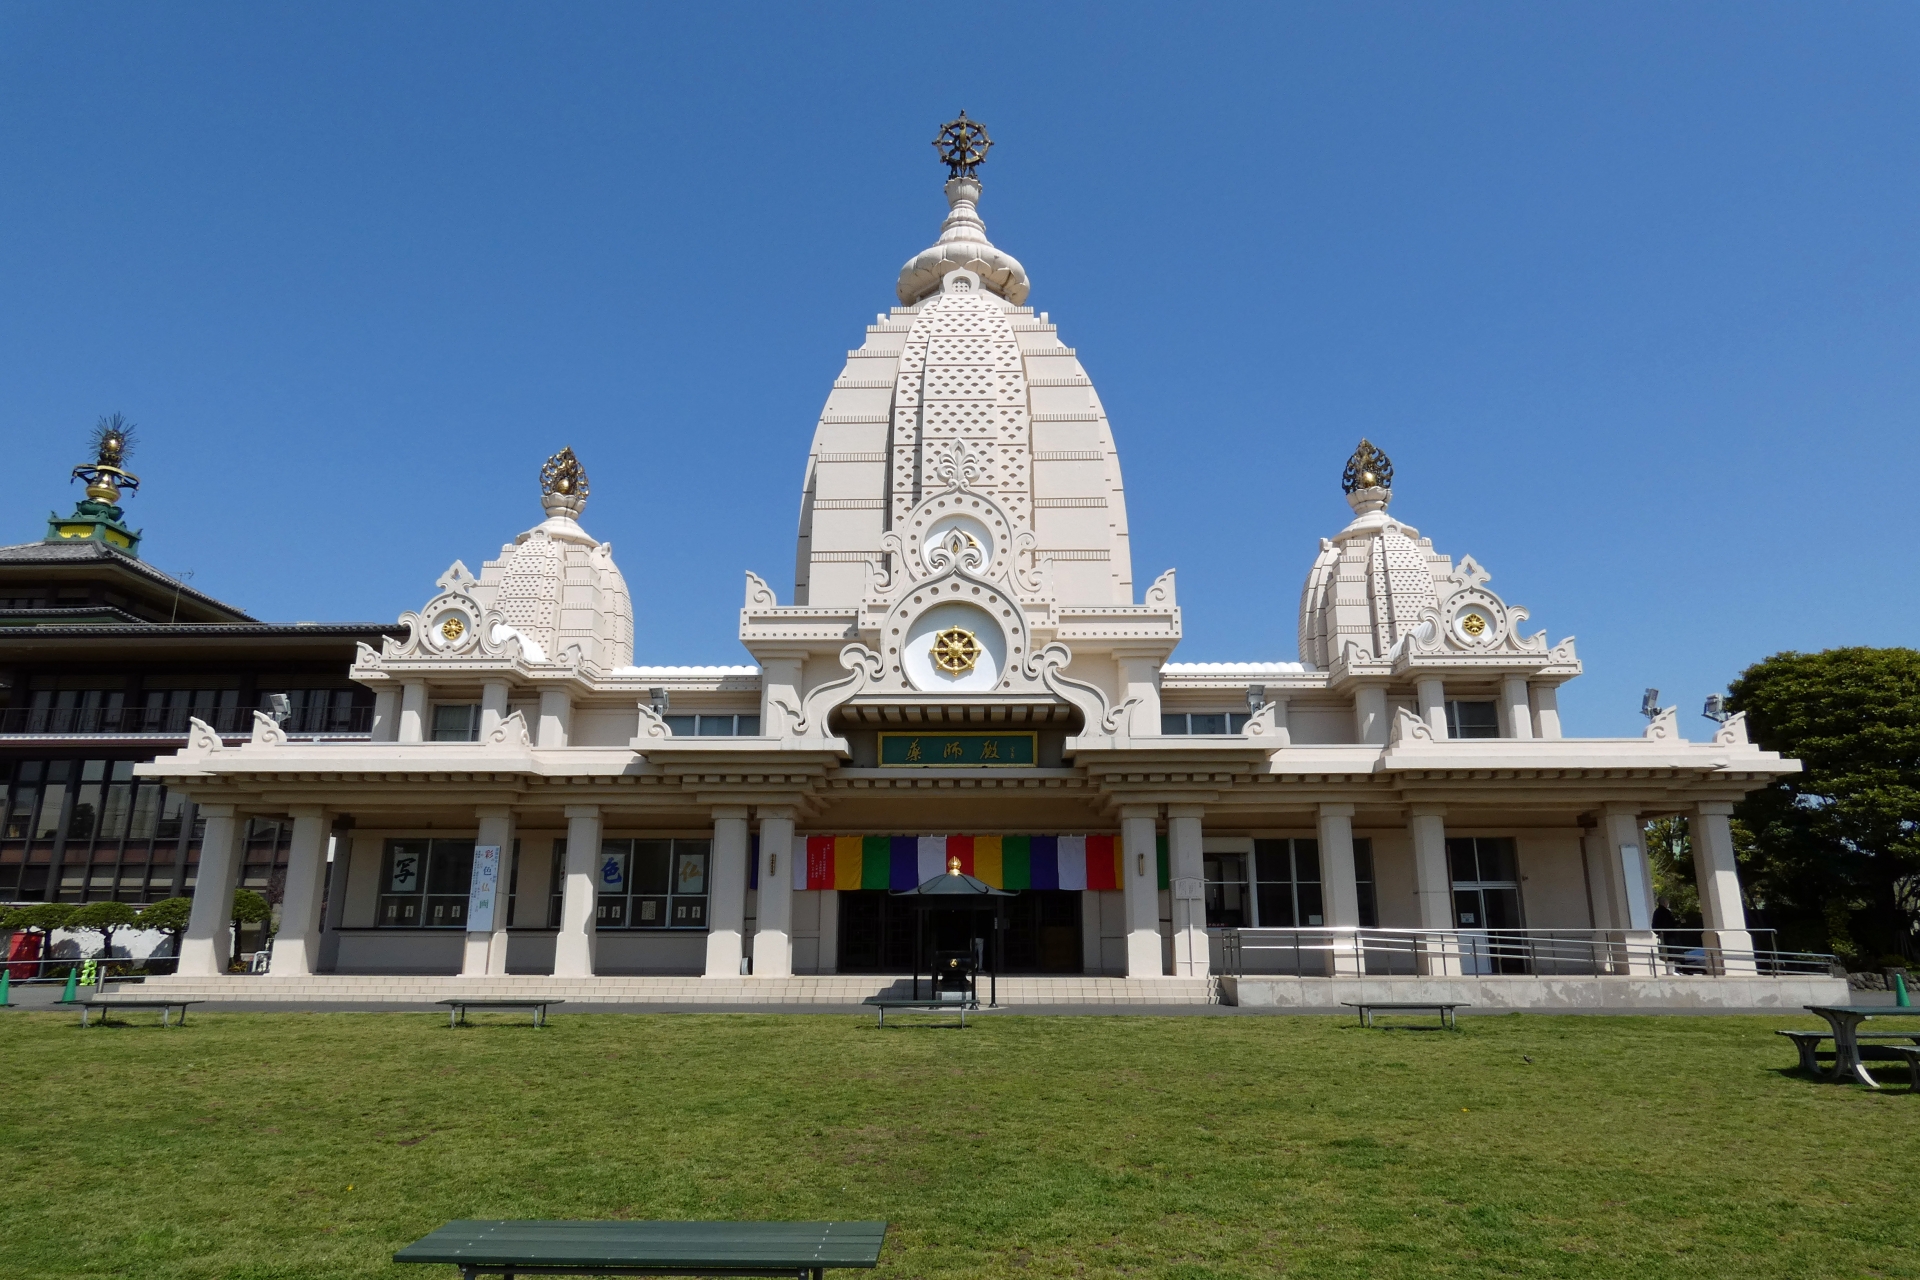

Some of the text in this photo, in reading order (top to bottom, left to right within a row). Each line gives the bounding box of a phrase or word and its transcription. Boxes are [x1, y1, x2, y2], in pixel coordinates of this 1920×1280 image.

[394, 857, 417, 883] 写
[478, 849, 494, 909] 彩色仏画
[601, 857, 622, 884] 色
[680, 861, 702, 883] 仏
